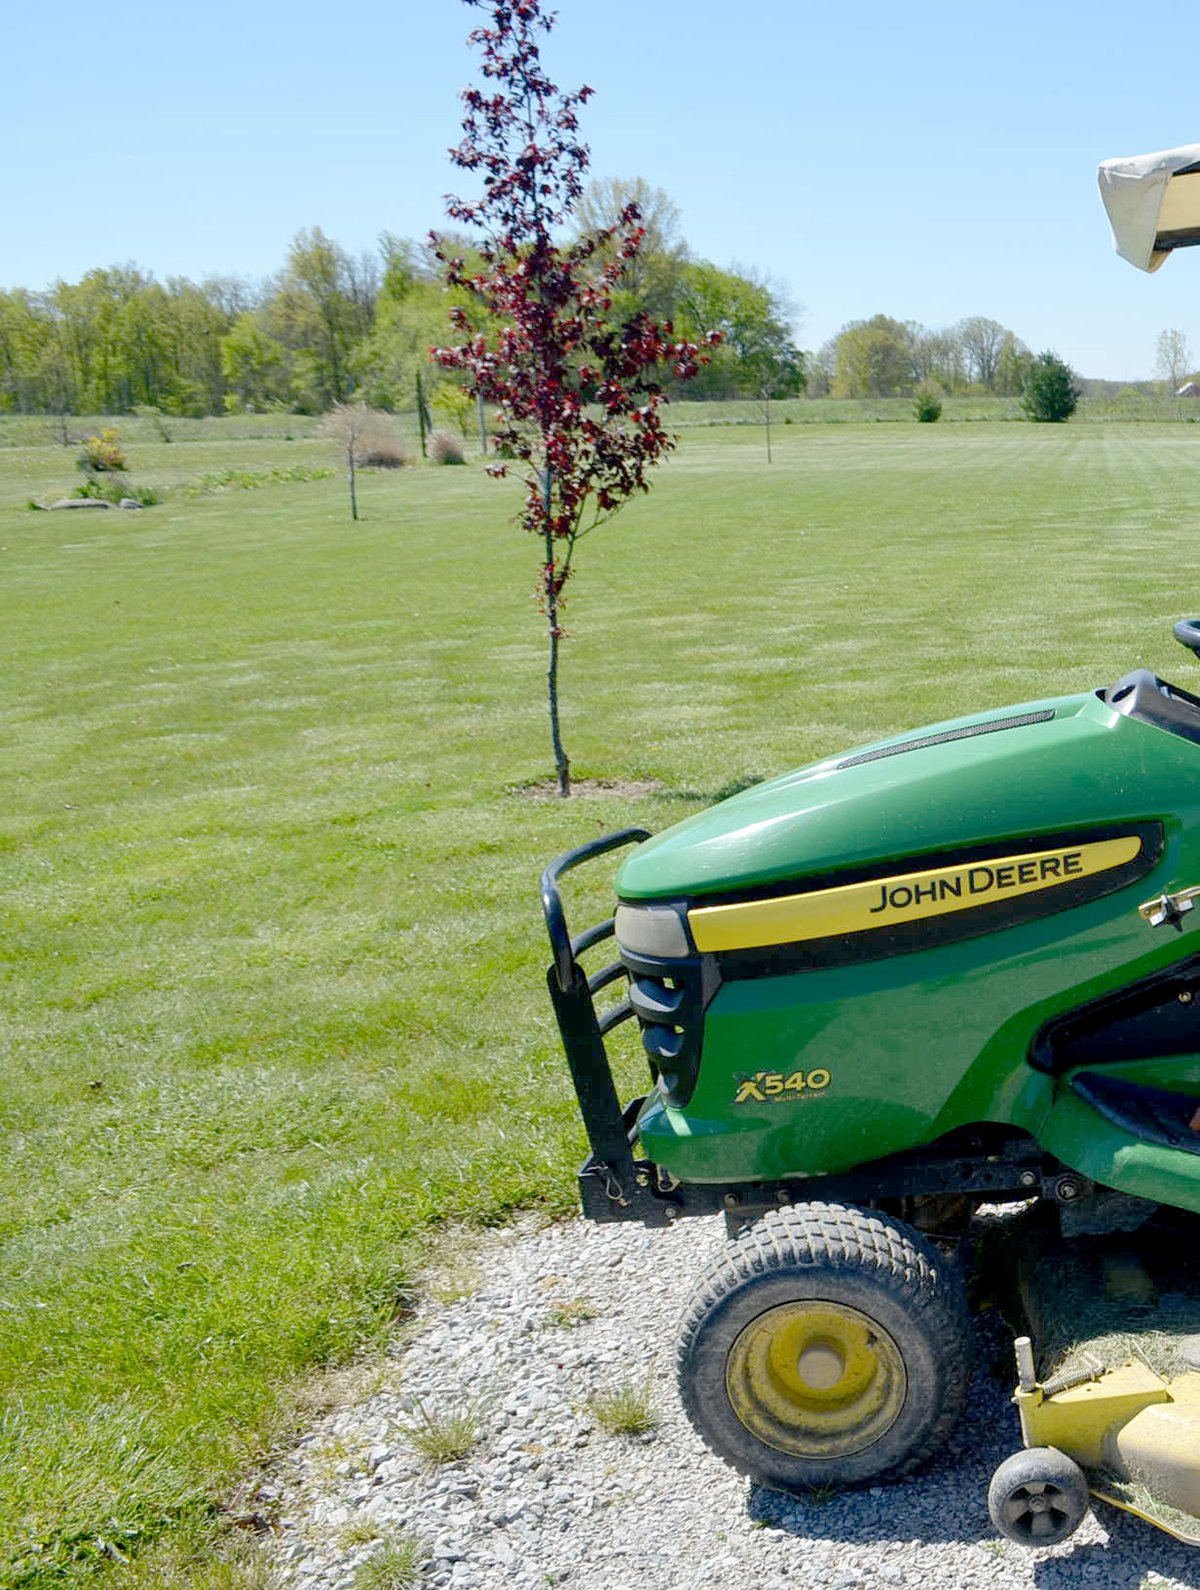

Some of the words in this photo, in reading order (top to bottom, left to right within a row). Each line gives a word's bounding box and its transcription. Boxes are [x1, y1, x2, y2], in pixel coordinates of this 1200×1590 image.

[870, 876, 962, 913] JOHN
[968, 853, 1083, 895] DEERE
[735, 1068, 831, 1103] X540
